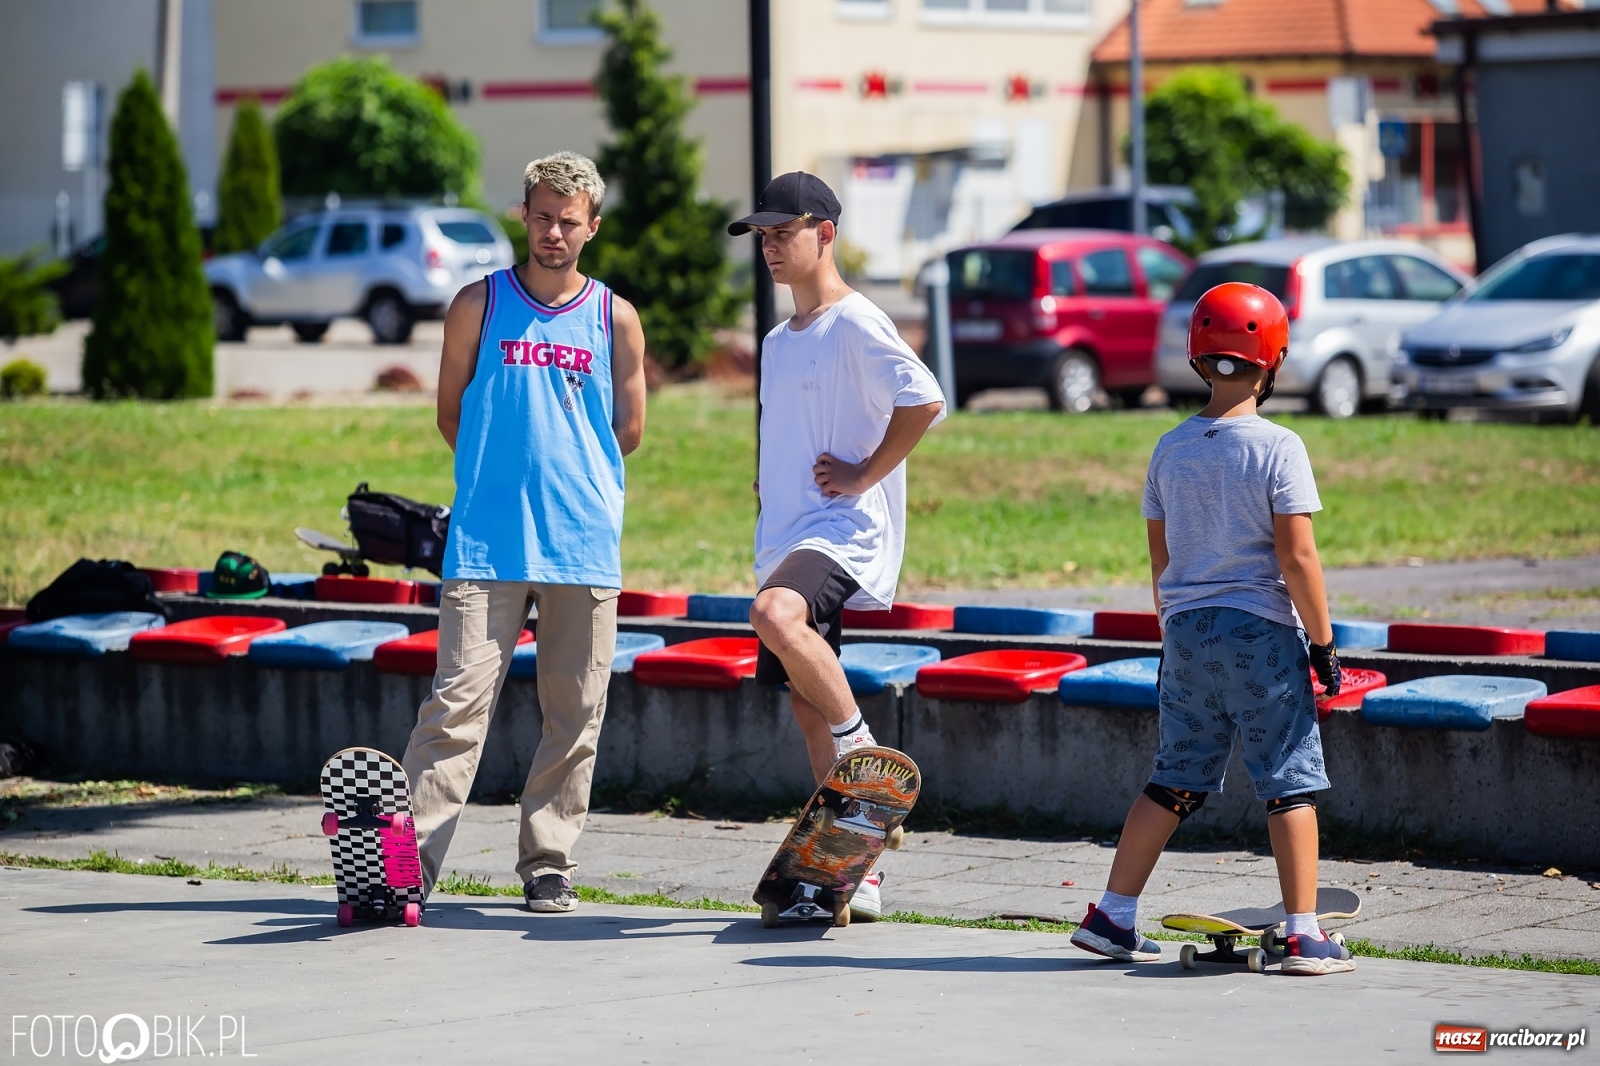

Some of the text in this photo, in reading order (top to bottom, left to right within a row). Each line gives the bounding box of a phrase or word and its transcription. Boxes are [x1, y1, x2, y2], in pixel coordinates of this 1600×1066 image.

[500, 340, 593, 375] TIGER
[1203, 429, 1219, 438] 4F
[1236, 652, 1254, 660] CATCH
[1273, 665, 1290, 681] SURF
